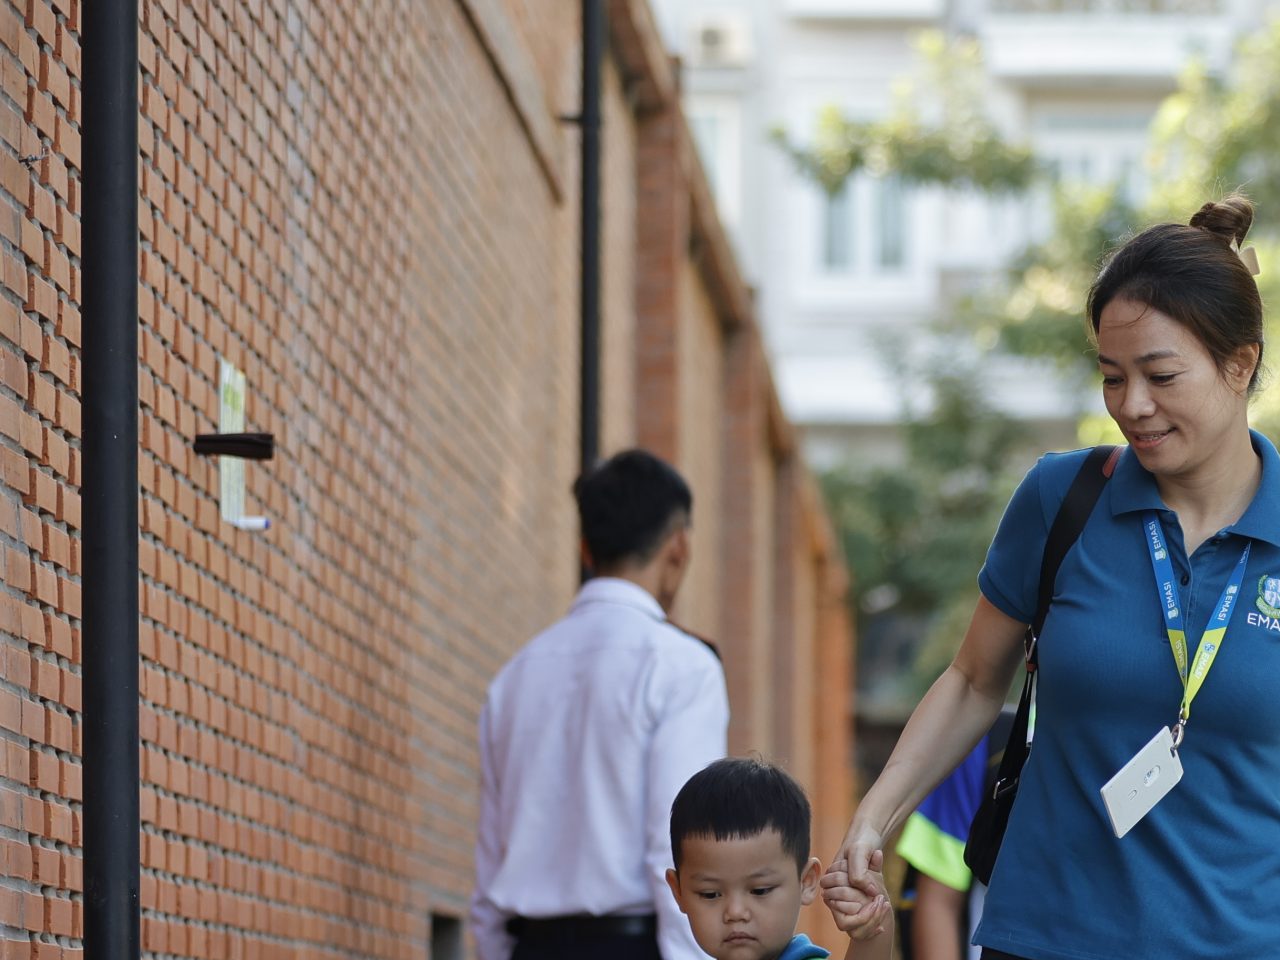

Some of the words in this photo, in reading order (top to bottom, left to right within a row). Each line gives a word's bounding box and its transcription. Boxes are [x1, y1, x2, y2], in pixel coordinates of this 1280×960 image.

[1149, 521, 1161, 550] EMASI
[1163, 581, 1175, 608] EMASI
[1217, 595, 1233, 622] EMASI
